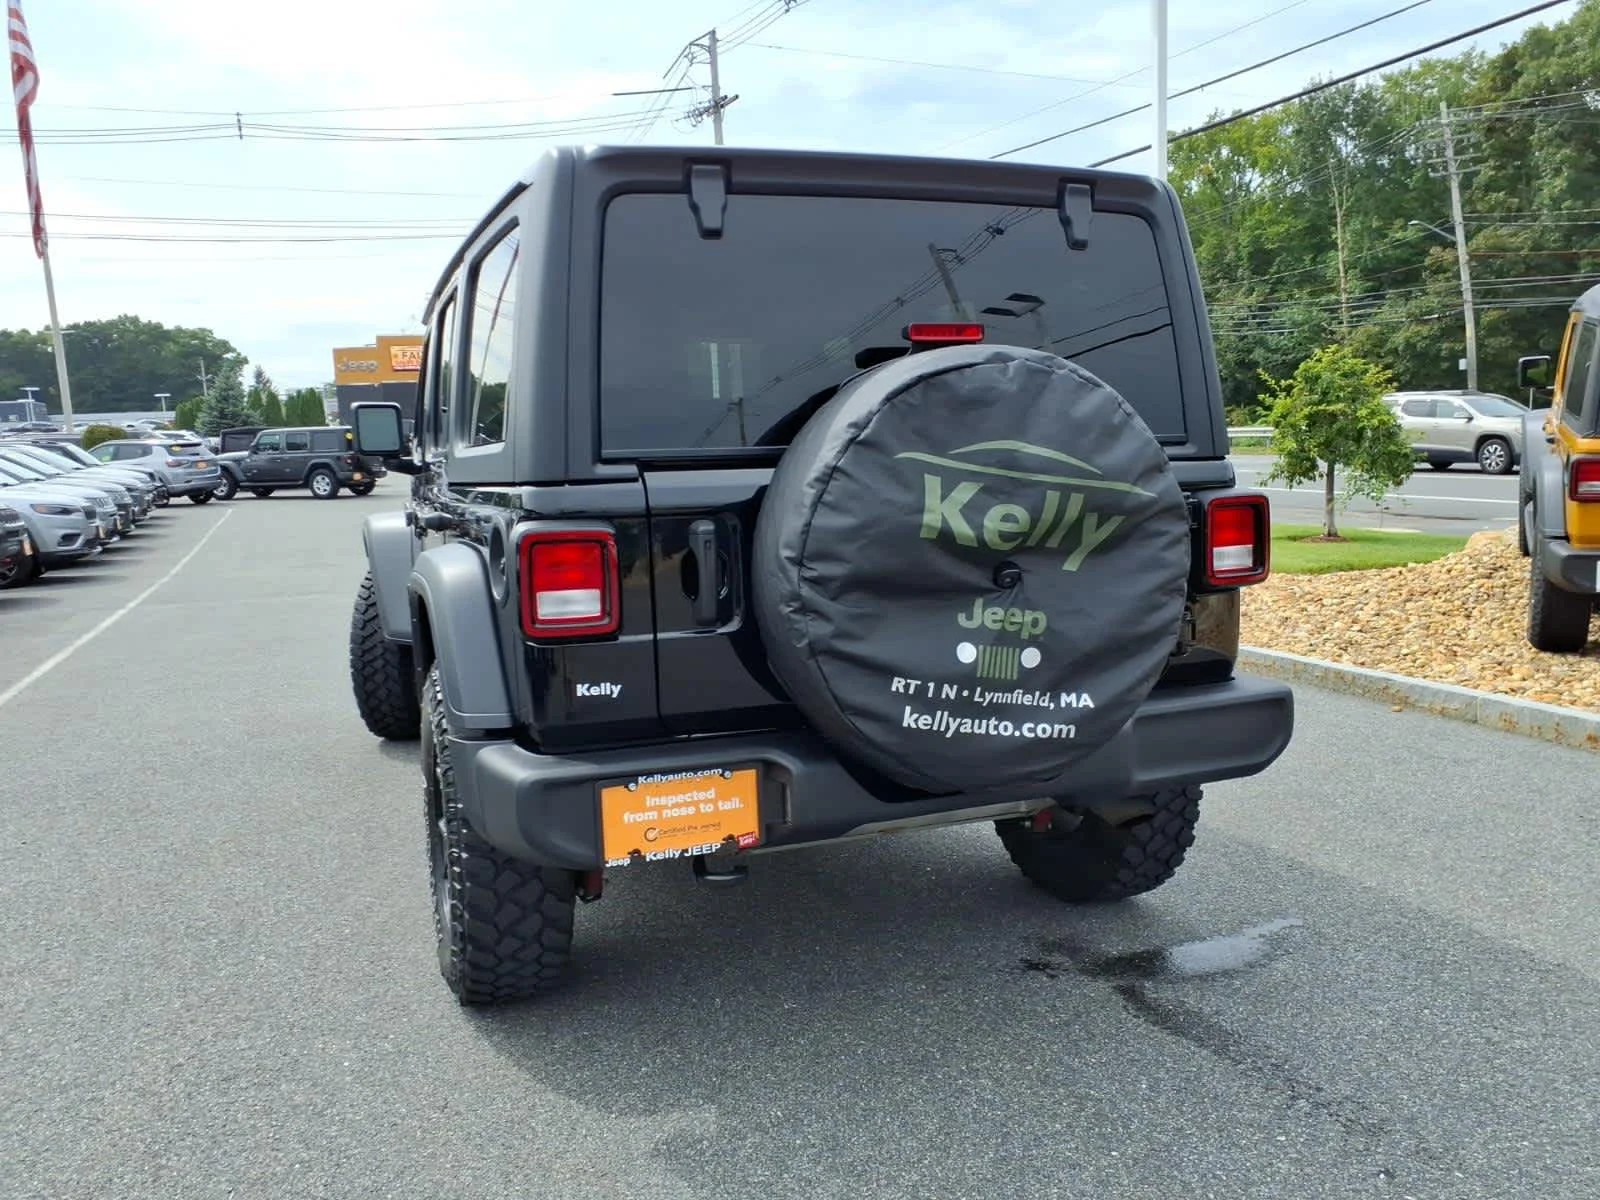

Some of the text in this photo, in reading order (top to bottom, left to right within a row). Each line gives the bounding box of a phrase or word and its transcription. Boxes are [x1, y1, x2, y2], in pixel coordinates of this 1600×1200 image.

[920, 473, 1126, 571] Kelly
[957, 598, 1047, 640] Jeep
[576, 682, 622, 698] Kelly
[891, 676, 1095, 710] RT 1 N Lynnfield, MA
[902, 705, 1076, 738] kellyauto.com
[638, 768, 722, 784] Kellyauto.com
[623, 798, 744, 824] from nose to tail.
[605, 855, 631, 869] Jeep
[645, 842, 722, 863] Kelly JEEP
